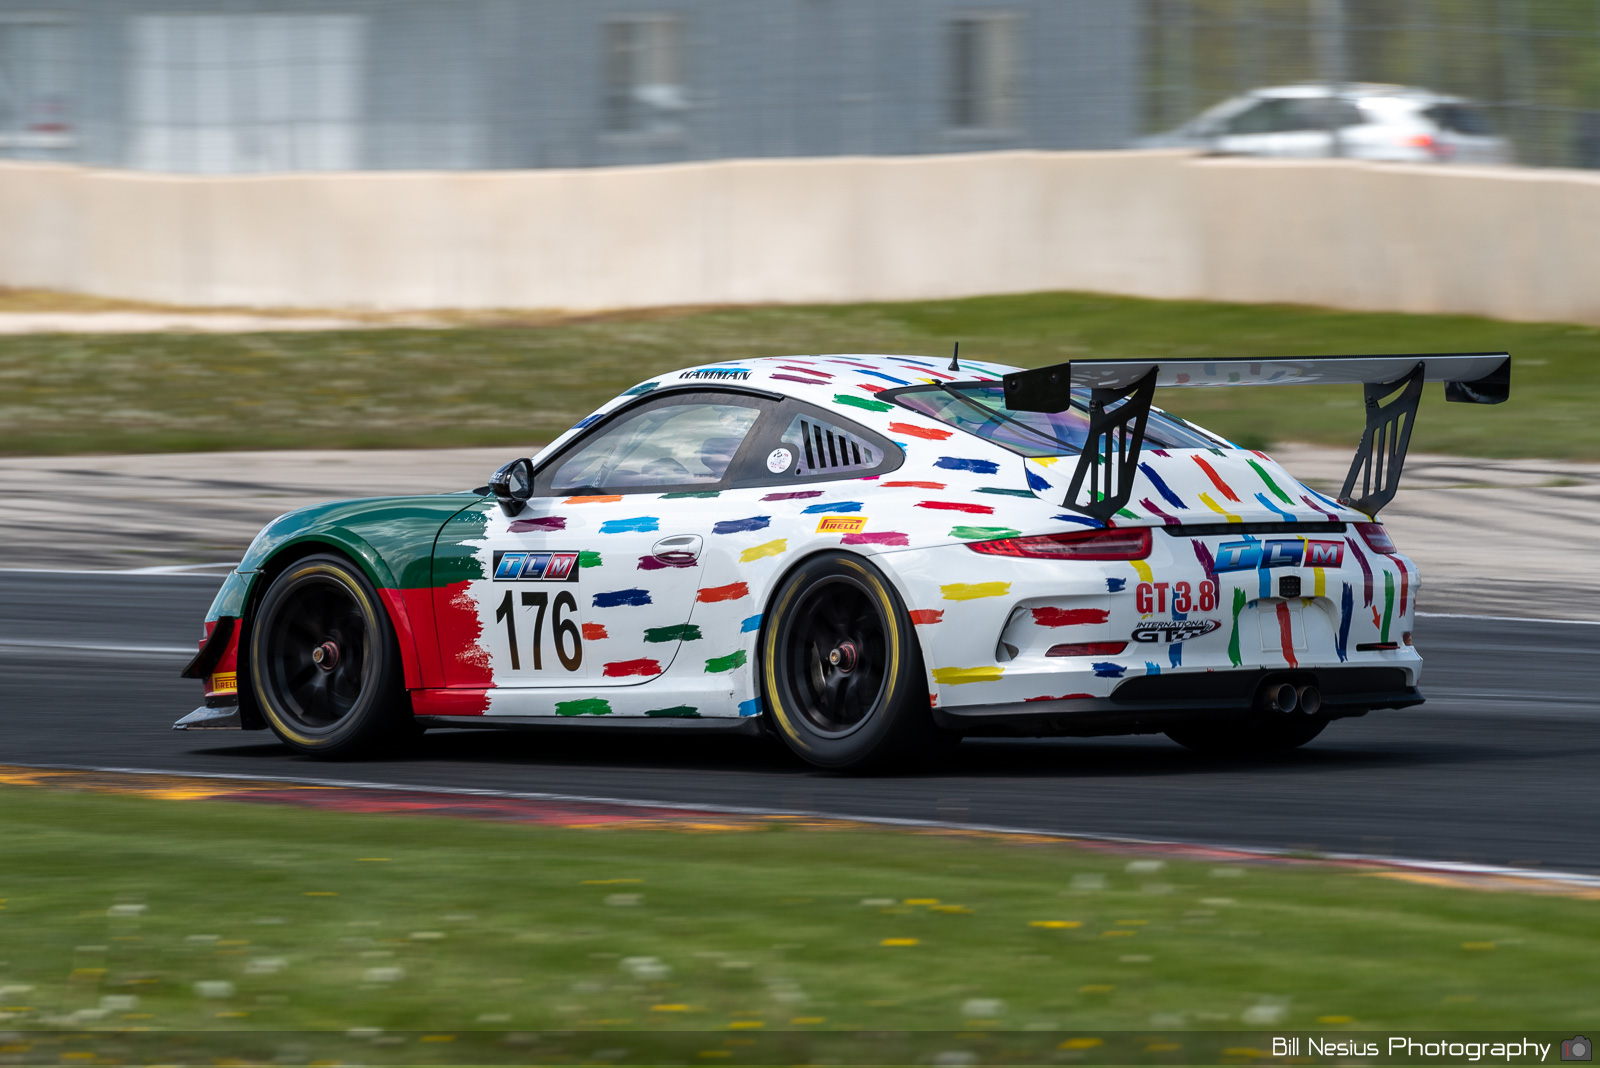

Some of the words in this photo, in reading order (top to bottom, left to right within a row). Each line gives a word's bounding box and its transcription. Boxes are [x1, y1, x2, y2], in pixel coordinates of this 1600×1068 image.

[679, 370, 753, 380] HAMMAN
[820, 519, 862, 529] PIRELLI
[1224, 543, 1338, 567] TLM
[504, 556, 571, 576] TLM
[1136, 582, 1169, 614] GT
[1175, 580, 1214, 612] 3.8
[496, 590, 583, 672] 176
[1136, 619, 1208, 628] INTERNATIONAL
[215, 676, 237, 690] PIRELL
